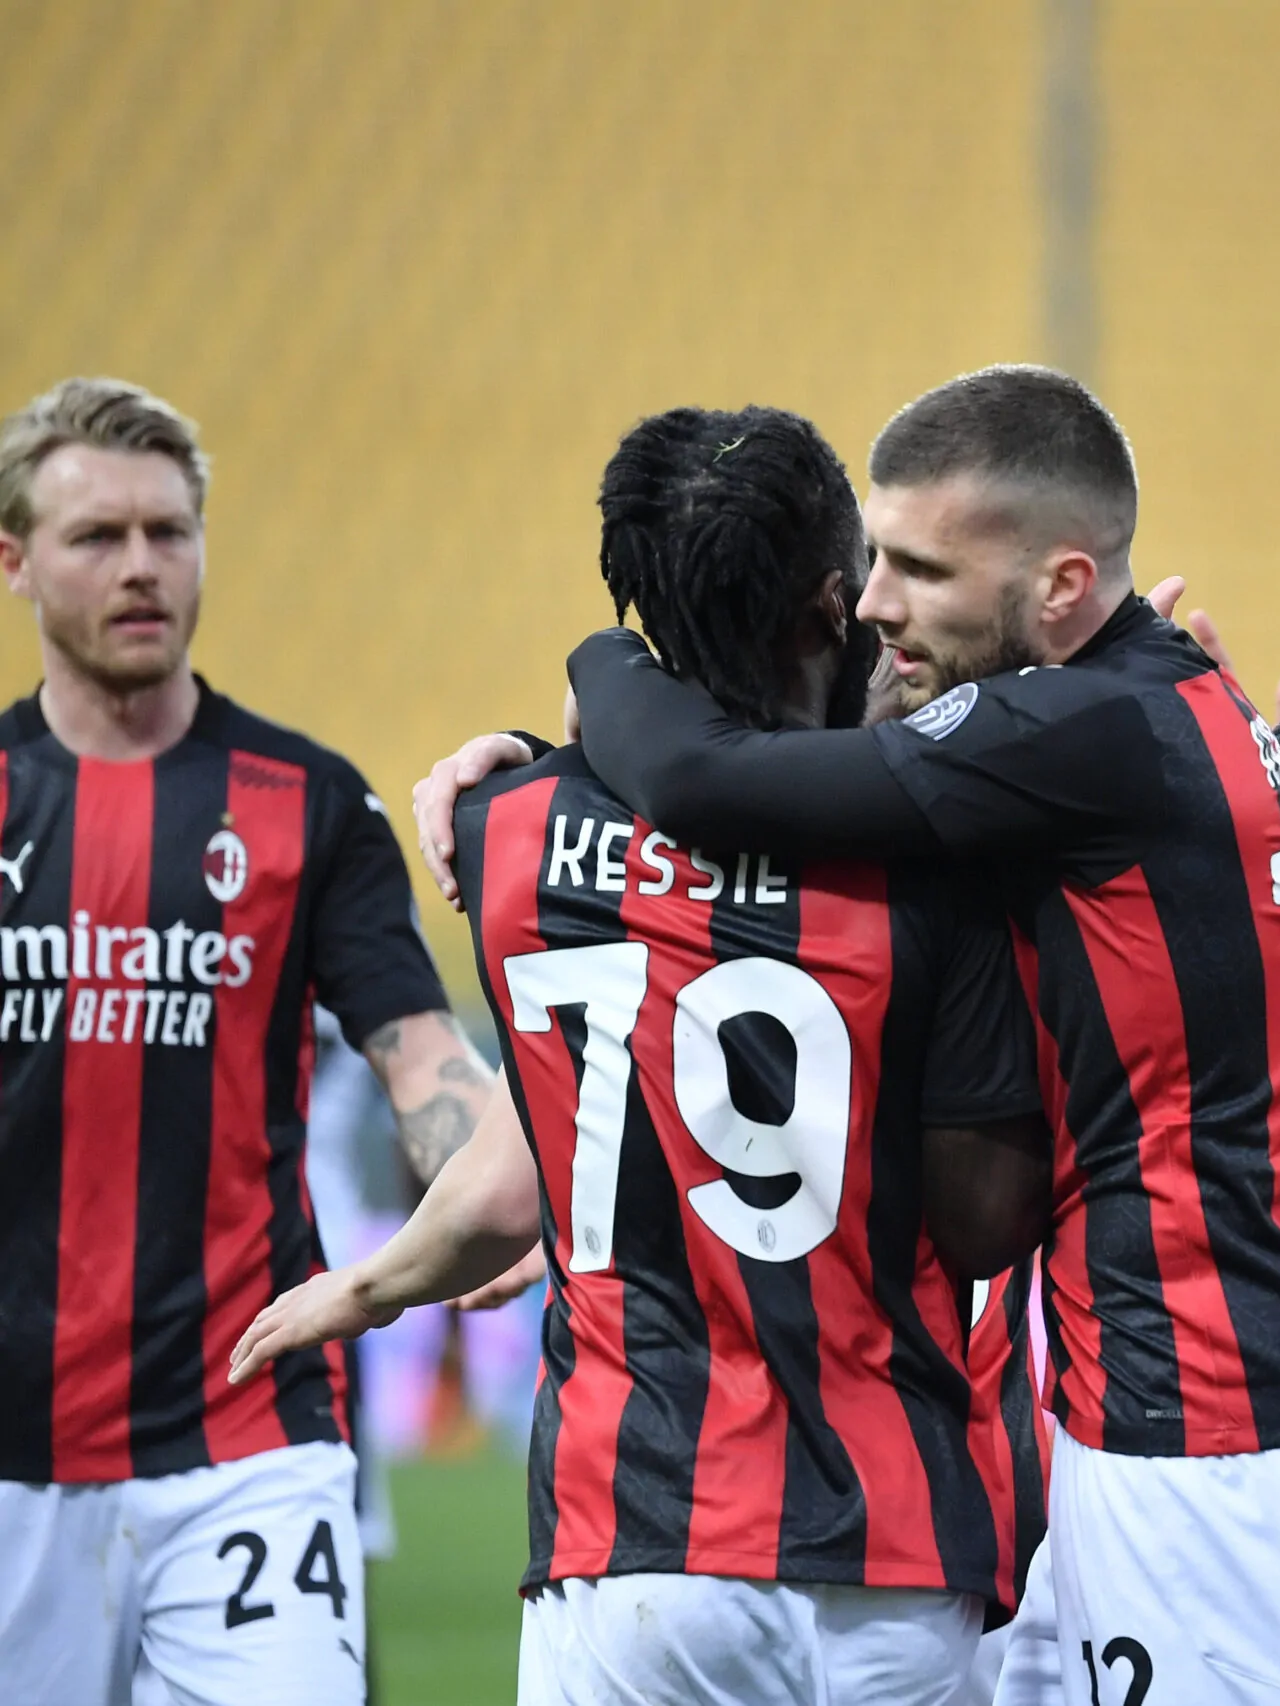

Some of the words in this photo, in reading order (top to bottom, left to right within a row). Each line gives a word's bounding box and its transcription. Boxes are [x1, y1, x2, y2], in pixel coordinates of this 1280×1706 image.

[547, 815, 788, 904] KESSIE
[0, 910, 255, 987] mirates
[0, 988, 63, 1042] FLY
[69, 988, 212, 1047] BETTER
[503, 941, 852, 1273] 79
[216, 1520, 346, 1629] 24
